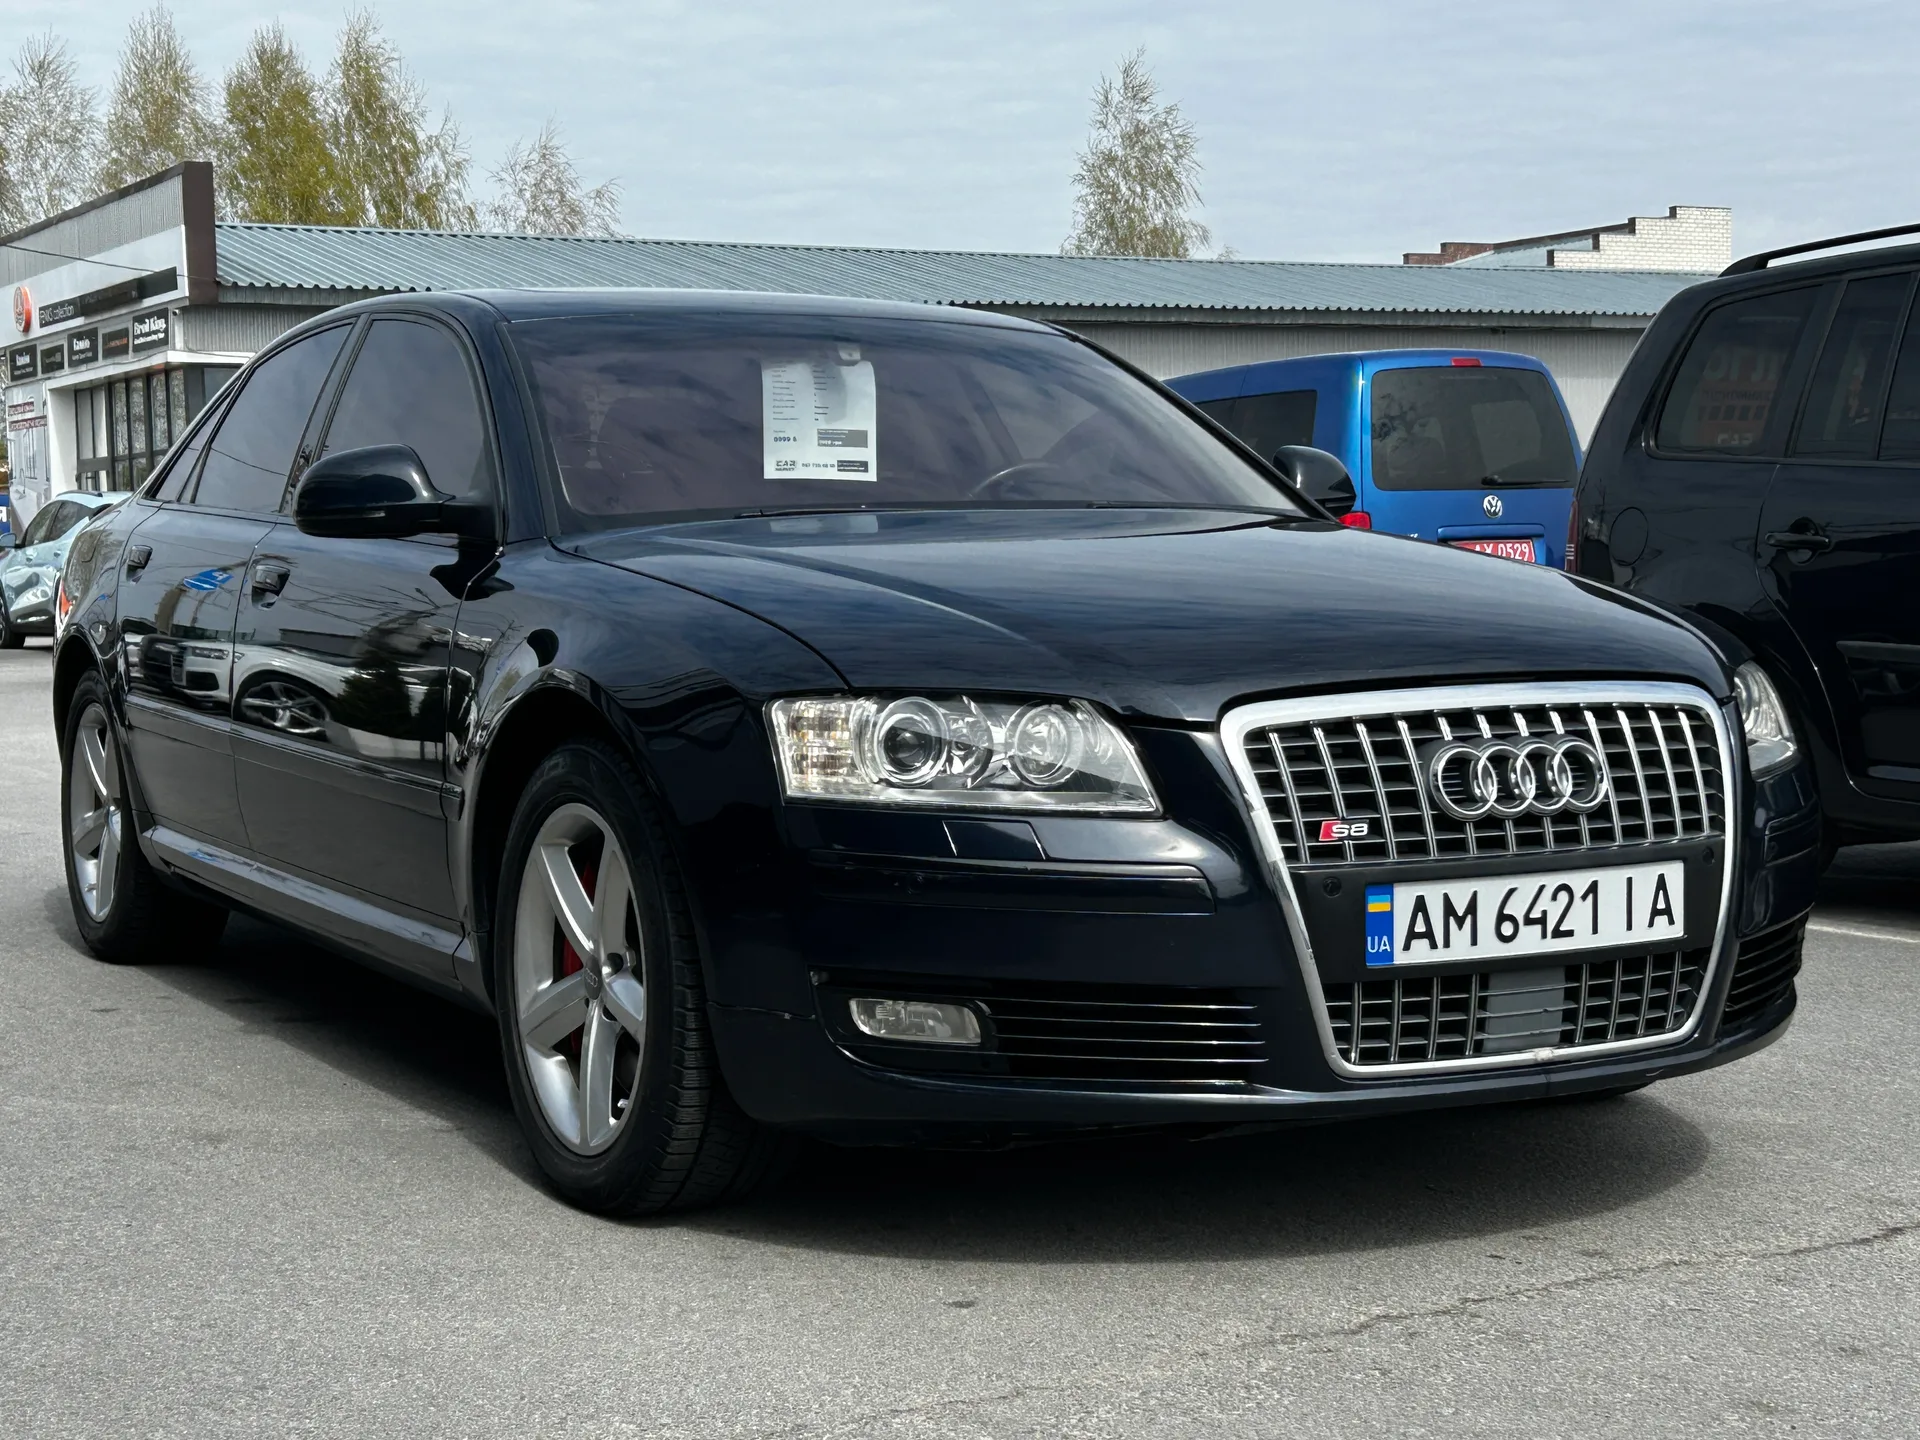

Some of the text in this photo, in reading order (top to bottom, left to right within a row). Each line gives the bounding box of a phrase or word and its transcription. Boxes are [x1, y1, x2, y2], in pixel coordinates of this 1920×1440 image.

[149, 315, 166, 332] King
[1498, 543, 1530, 561] 0529
[1330, 823, 1368, 838] S8
[1402, 872, 1676, 952] AM 6421 IA
[1366, 935, 1391, 953] UA
